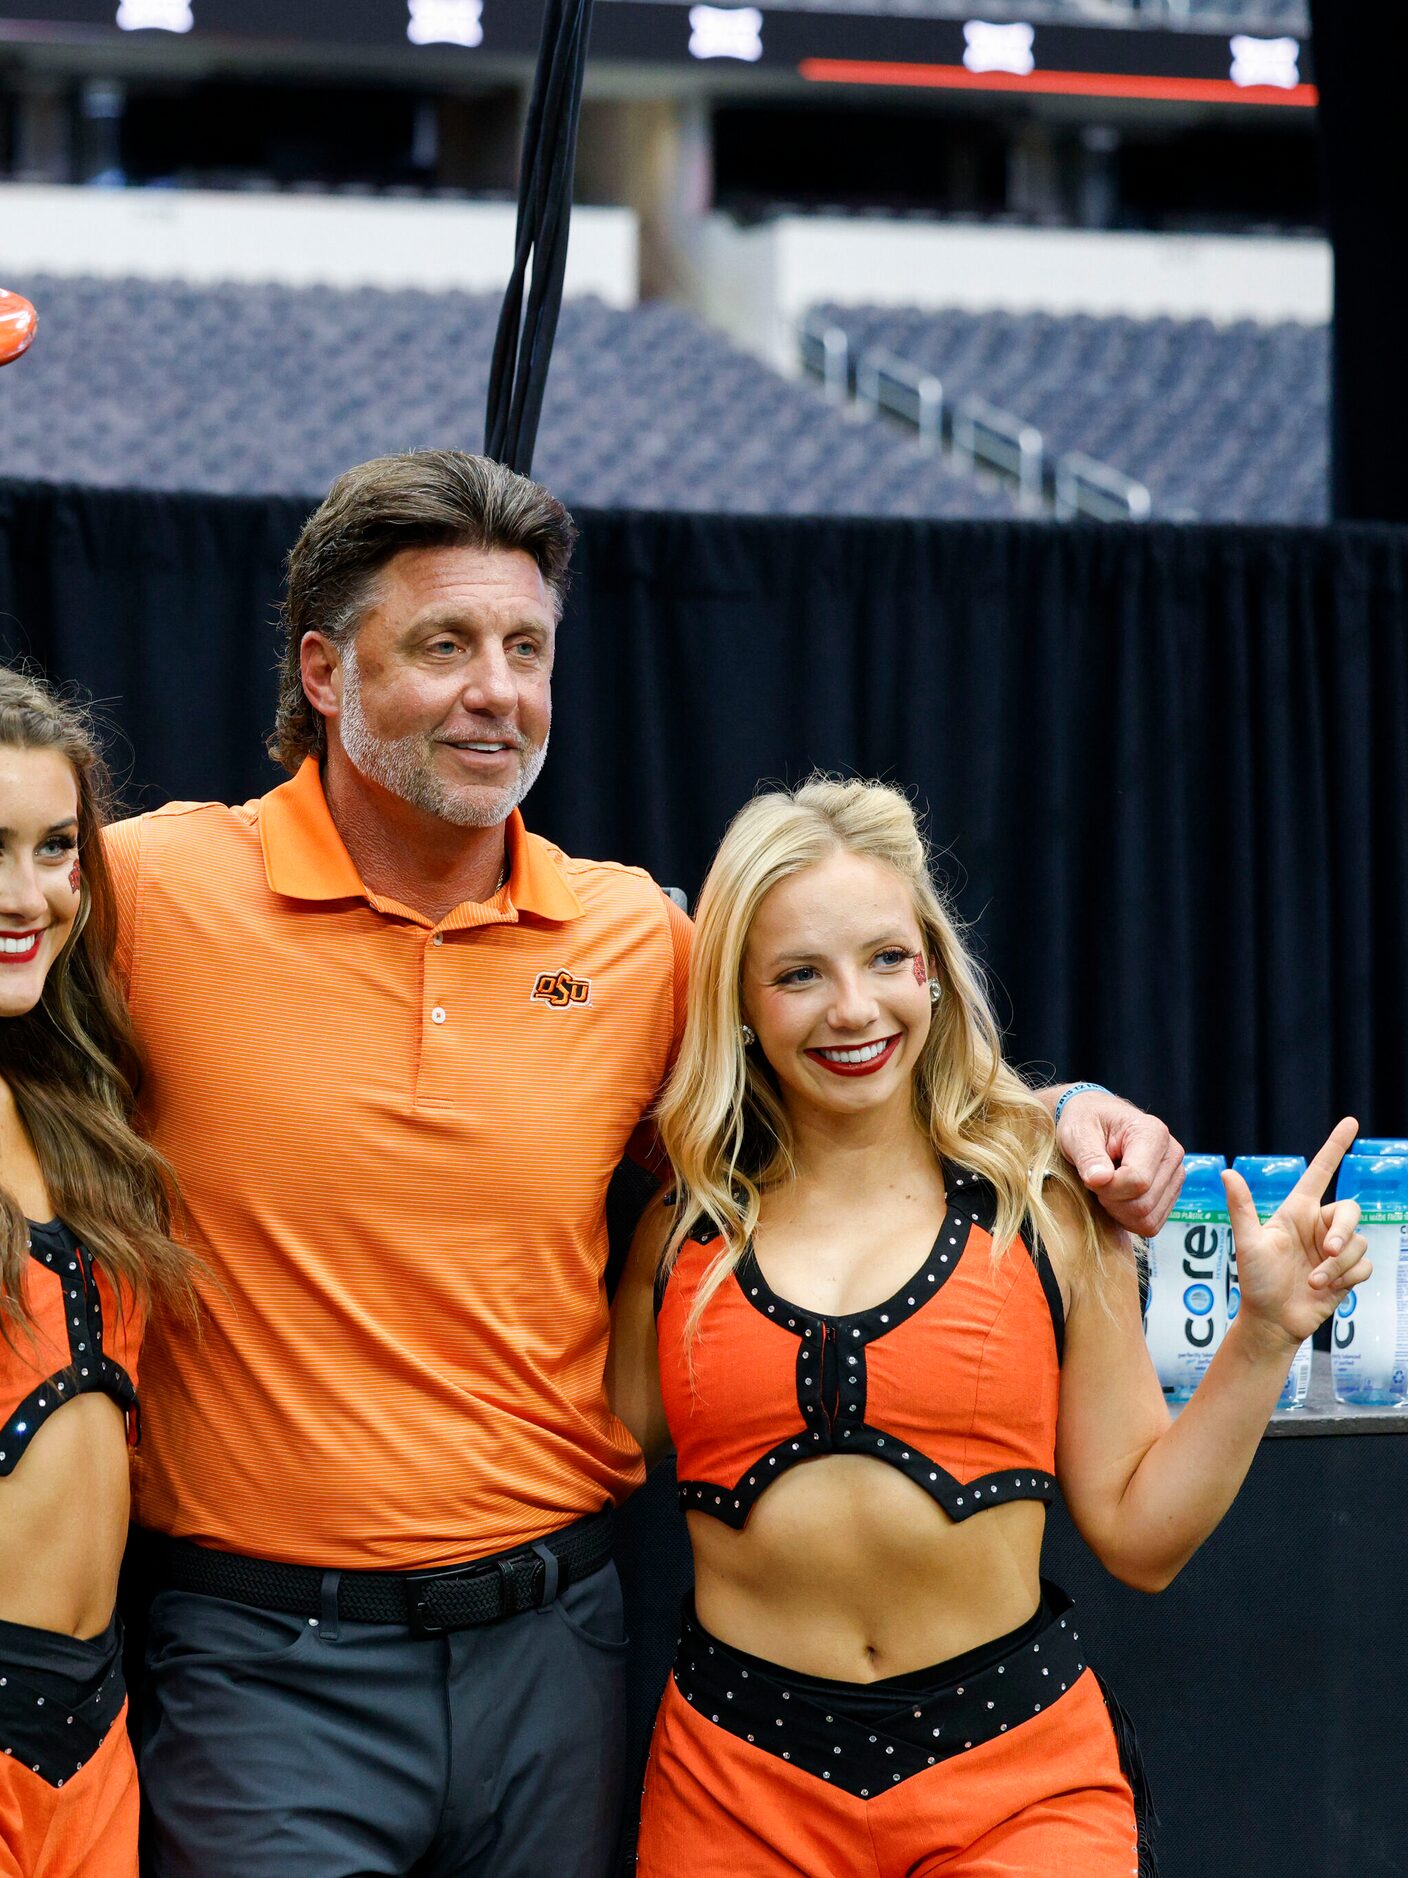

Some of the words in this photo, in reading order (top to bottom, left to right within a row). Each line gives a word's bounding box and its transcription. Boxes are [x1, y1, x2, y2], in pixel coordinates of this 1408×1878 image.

[530, 968, 592, 1010] OSU
[1183, 1225, 1218, 1348] core
[1335, 1290, 1357, 1349] co
